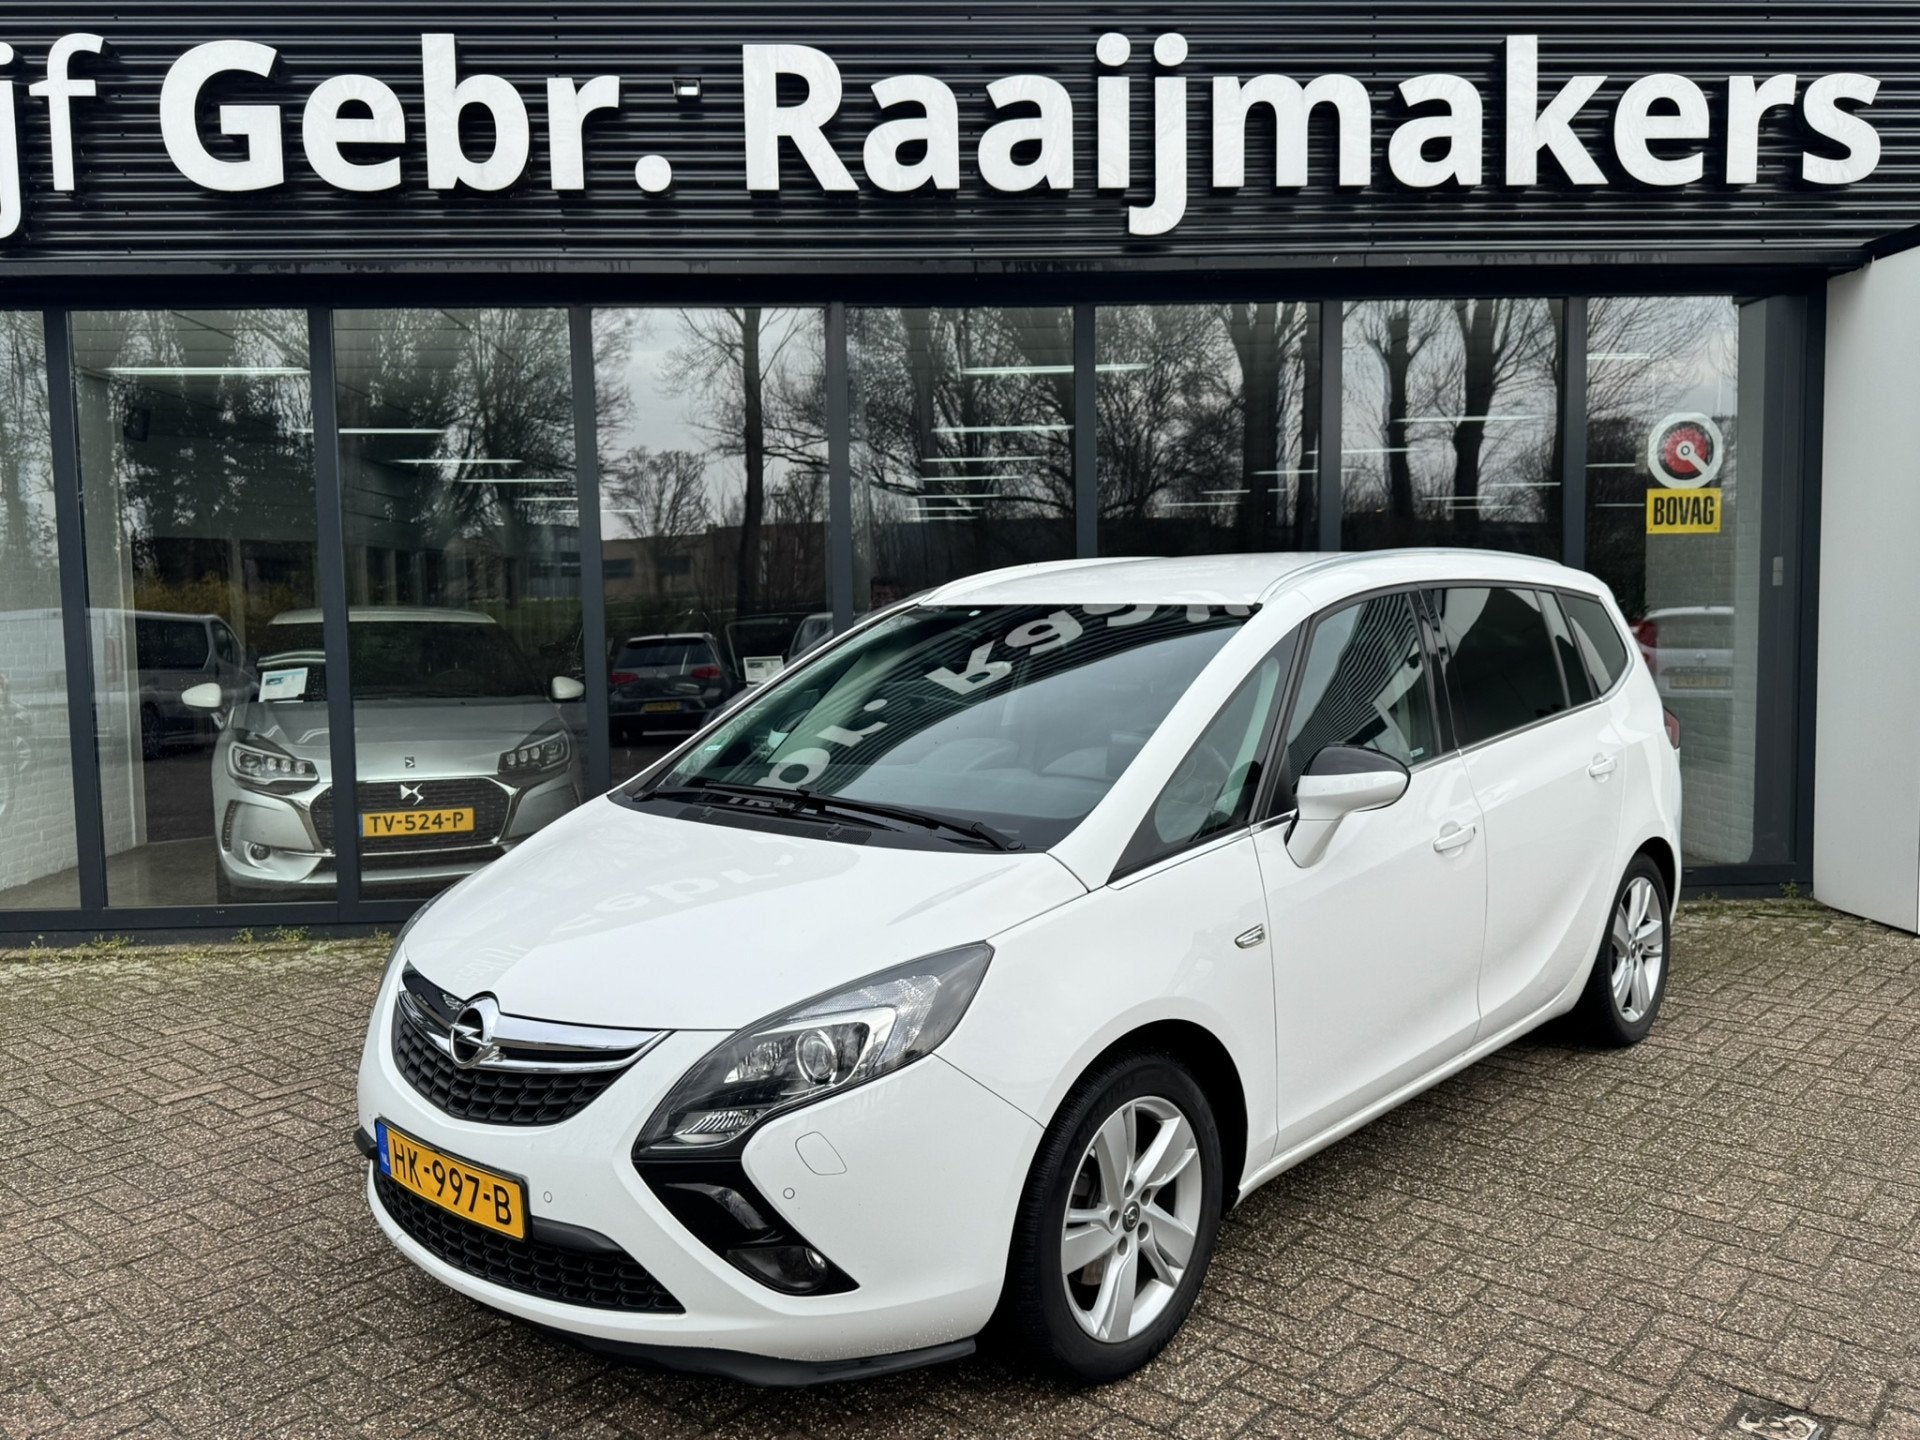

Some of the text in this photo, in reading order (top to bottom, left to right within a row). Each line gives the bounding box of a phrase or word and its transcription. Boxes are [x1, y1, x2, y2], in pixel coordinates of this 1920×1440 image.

[160, 33, 673, 192] Gebr.
[742, 33, 1882, 235] Raaijmakers
[1653, 496, 1715, 526] BOVAG
[369, 811, 464, 833] TV-524-P
[392, 1138, 512, 1226] HK-997-B
